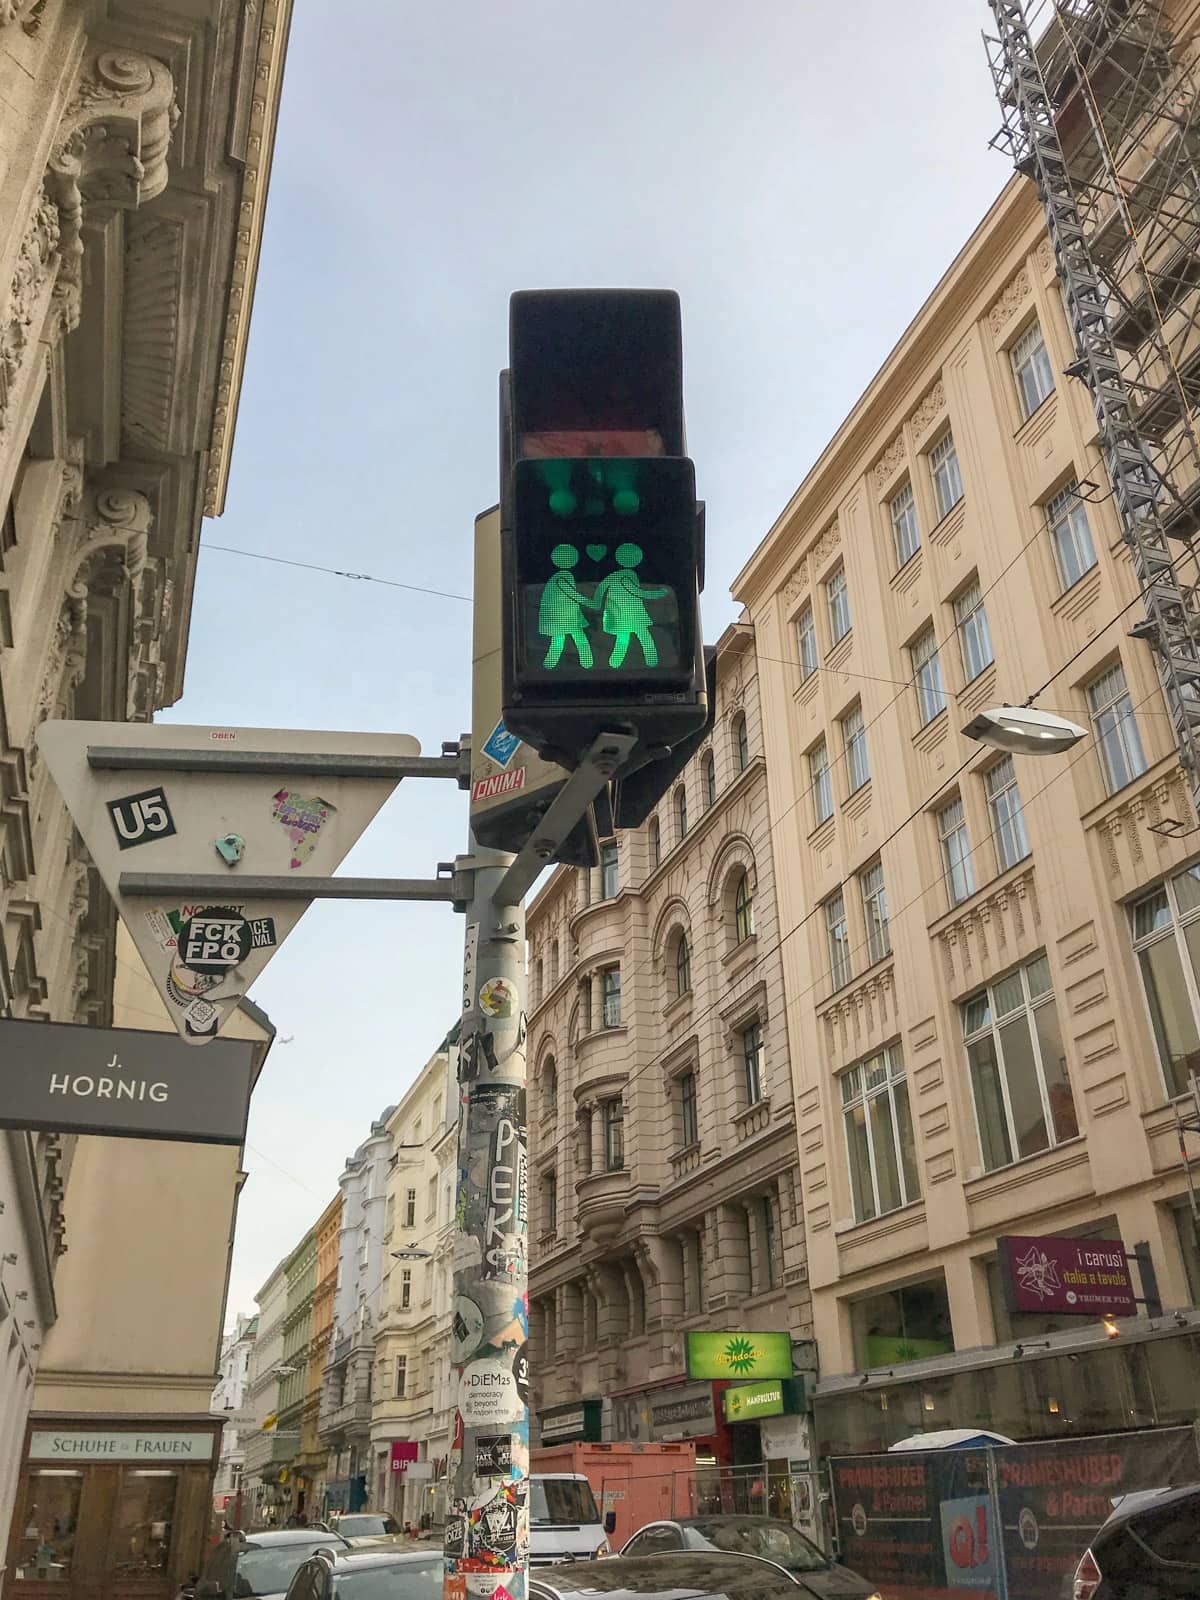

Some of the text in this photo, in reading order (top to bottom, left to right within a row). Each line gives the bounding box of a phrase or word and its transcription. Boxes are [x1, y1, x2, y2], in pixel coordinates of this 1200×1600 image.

[211, 732, 236, 740] OBEN
[112, 795, 169, 840] U5
[188, 923, 242, 942] FCK
[186, 940, 240, 960] FPÖ
[107, 1054, 122, 1068] J.
[49, 1074, 168, 1102] HORNIG
[1077, 1248, 1123, 1267] i carusi
[1063, 1267, 1127, 1286] italia a tavola
[468, 1391, 504, 1400] democracy
[474, 1400, 498, 1408] beyond
[52, 1438, 116, 1453] SCHUHE
[134, 1439, 192, 1453] FRAUEN
